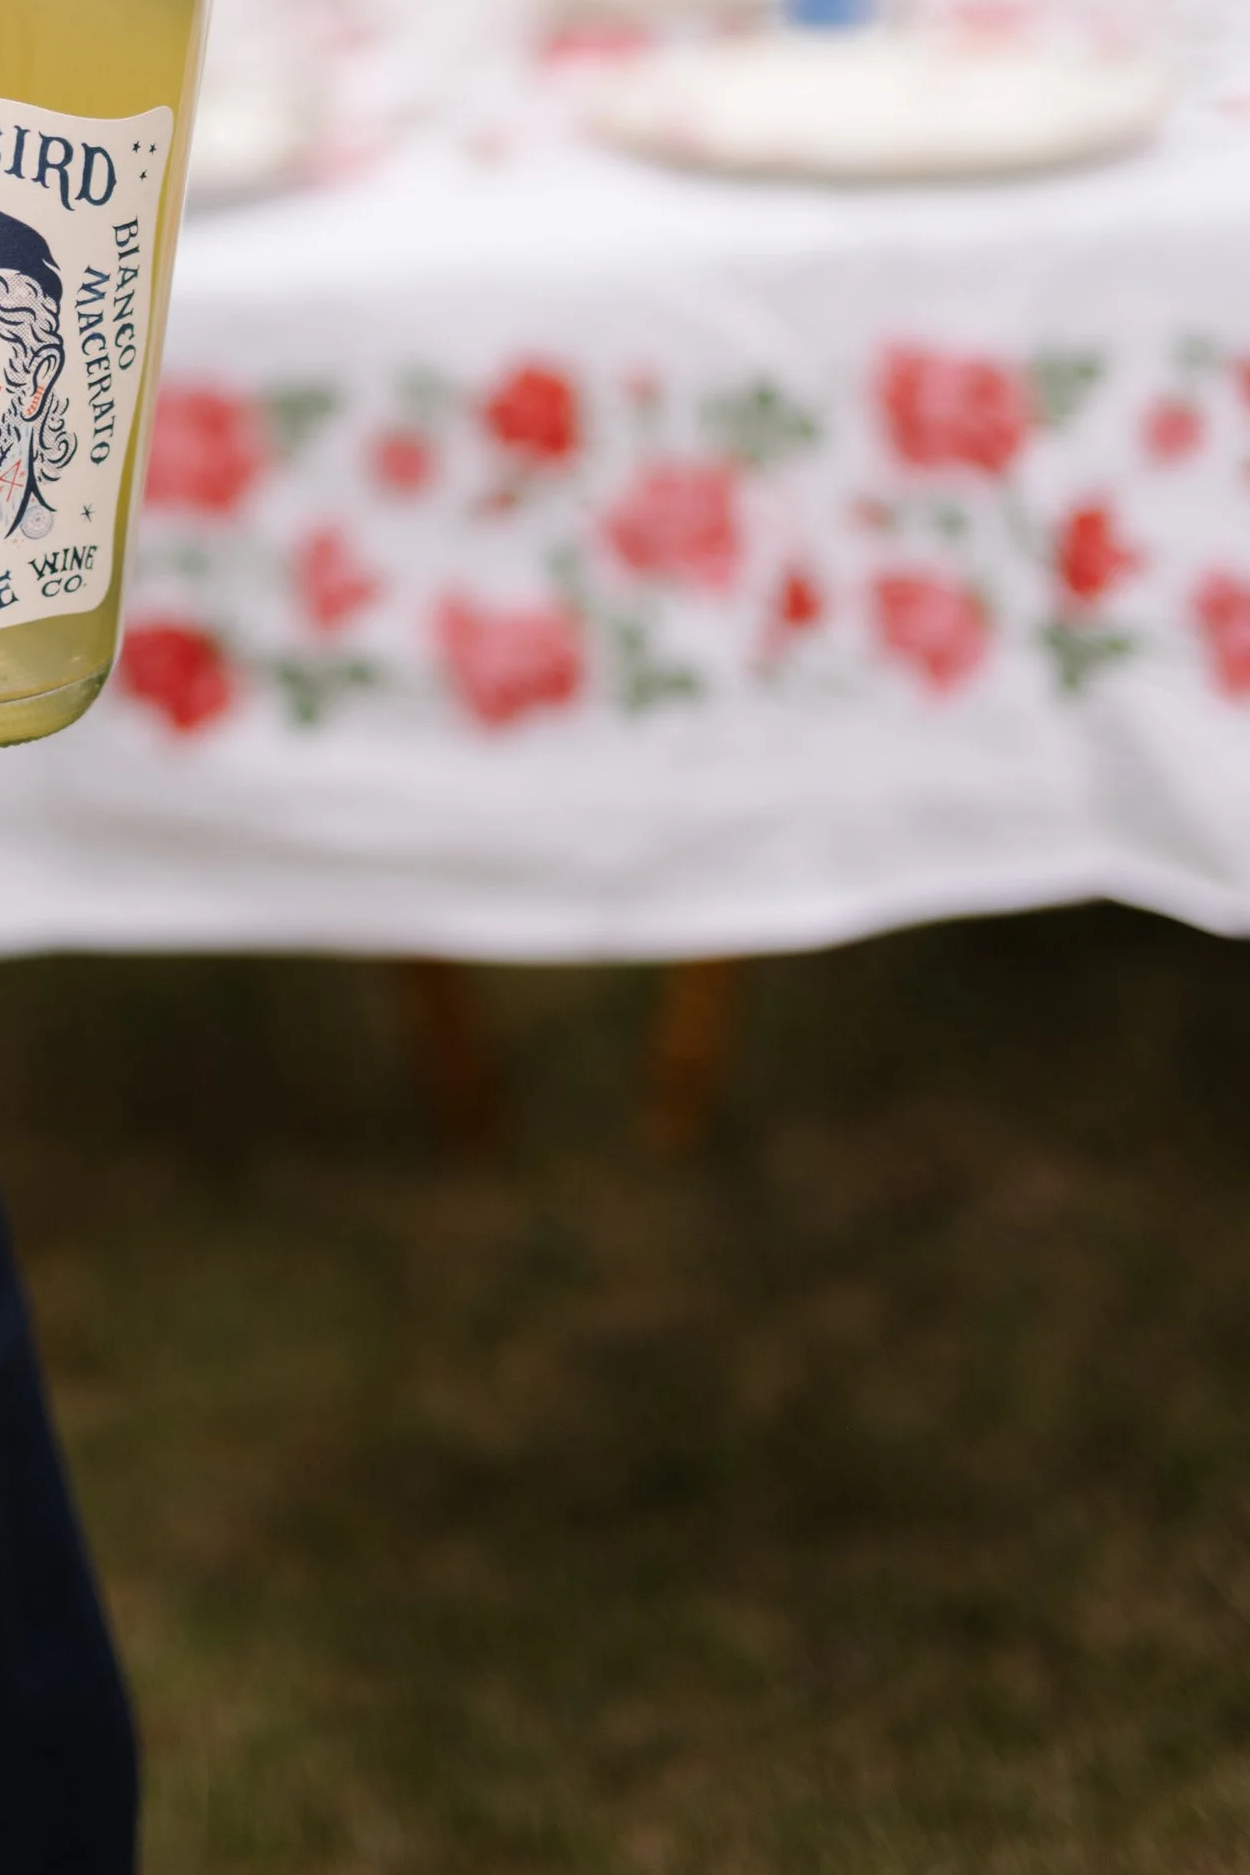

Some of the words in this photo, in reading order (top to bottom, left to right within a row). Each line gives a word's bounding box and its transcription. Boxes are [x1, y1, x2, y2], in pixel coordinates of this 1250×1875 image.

[74, 265, 116, 465] MACERATO
[112, 215, 141, 371] BIANCO
[28, 545, 99, 580] WINE
